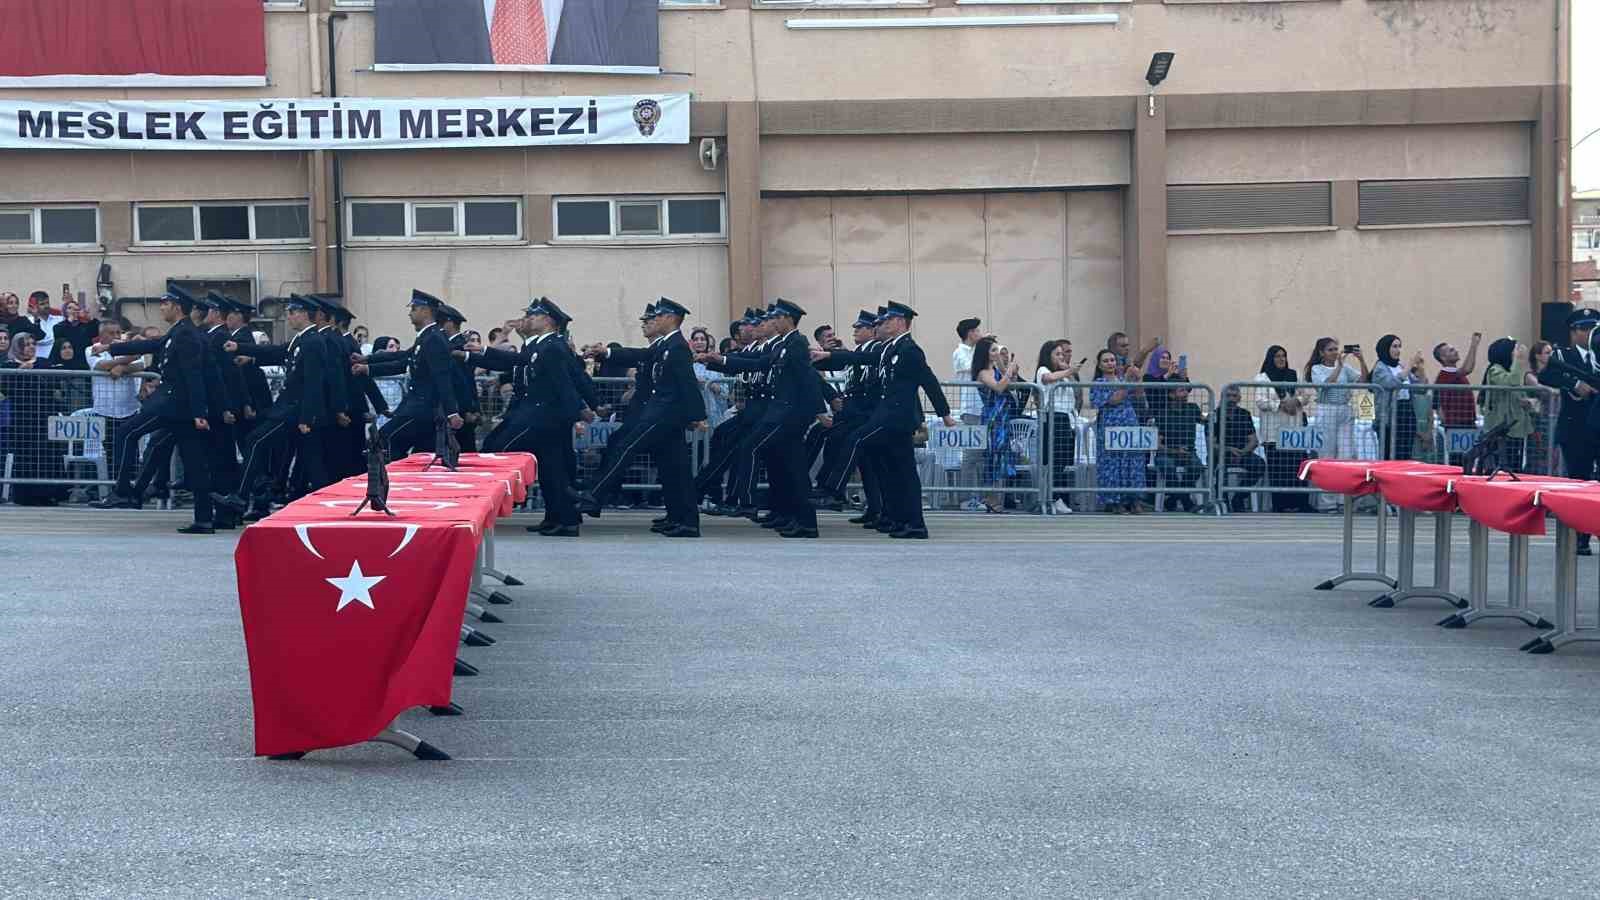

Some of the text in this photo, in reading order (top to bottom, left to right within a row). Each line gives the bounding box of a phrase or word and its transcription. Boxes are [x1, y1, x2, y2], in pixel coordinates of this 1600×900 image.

[18, 100, 598, 140] MESLEK EĞİTİM MERKEZİ
[55, 417, 100, 439] POLİS
[938, 427, 982, 448] POLİS
[1108, 427, 1152, 449] POLİS
[1280, 428, 1323, 449] POLİS
[1451, 432, 1481, 450] POL
